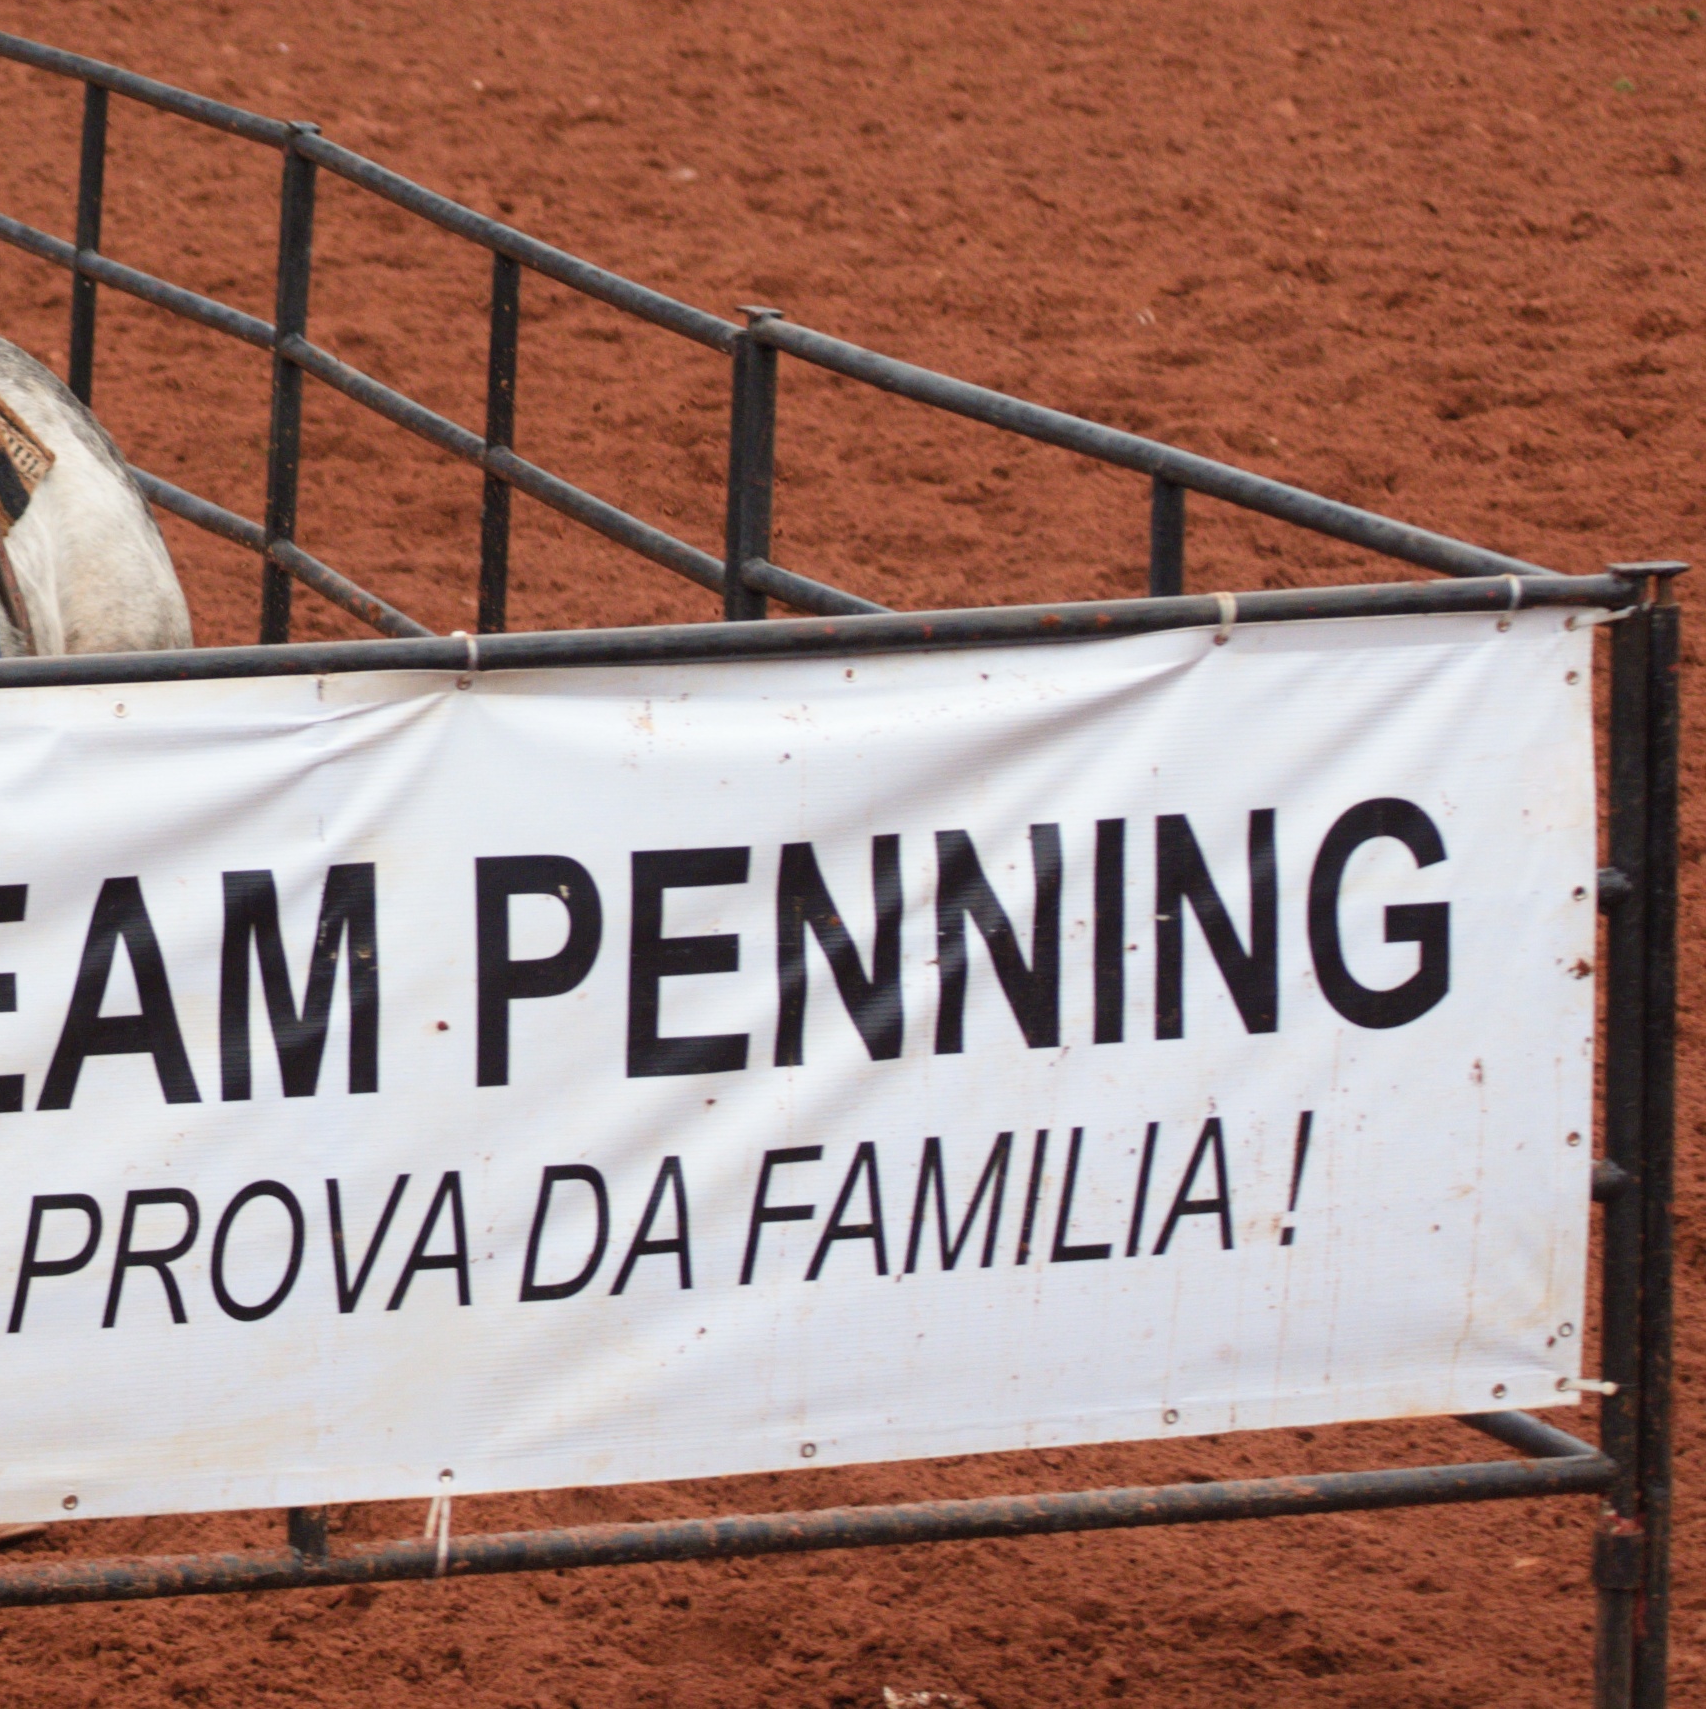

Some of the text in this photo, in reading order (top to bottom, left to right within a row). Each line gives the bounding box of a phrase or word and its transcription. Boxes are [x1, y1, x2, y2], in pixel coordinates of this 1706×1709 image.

[474, 796, 1452, 1088] PENNING
[6, 1170, 472, 1334] PROVA
[518, 1154, 693, 1304] DA
[739, 1116, 1236, 1287] FAMILIA
